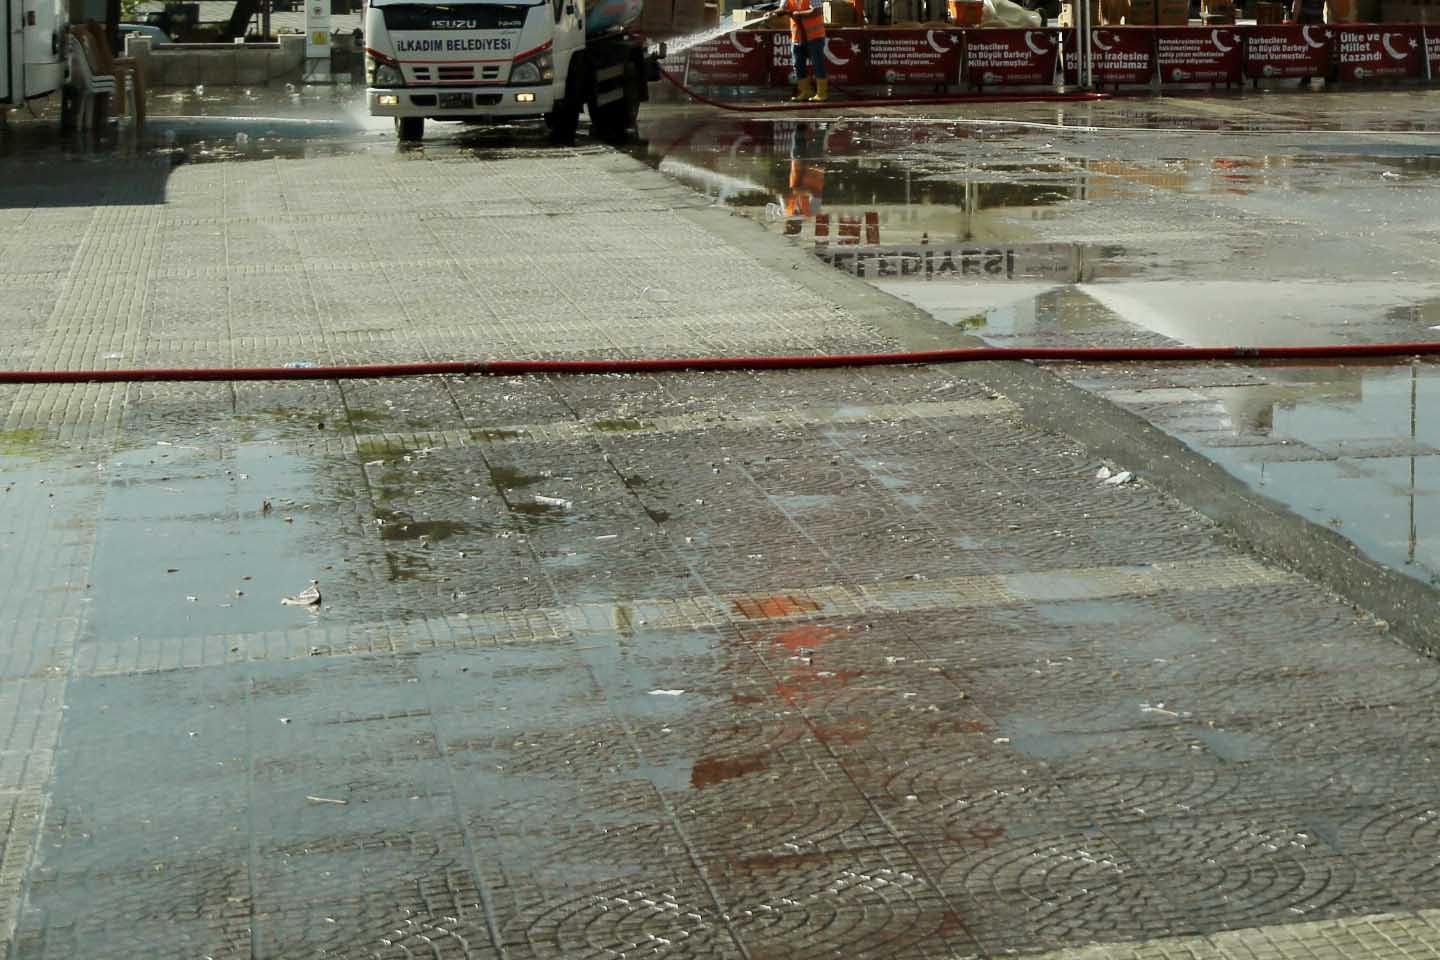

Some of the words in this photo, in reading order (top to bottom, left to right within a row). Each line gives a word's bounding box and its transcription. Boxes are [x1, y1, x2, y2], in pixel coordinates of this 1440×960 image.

[432, 19, 477, 29] ISUZU
[1341, 31, 1365, 42] Ülke
[1367, 33, 1380, 41] ve
[397, 40, 443, 52] İLKADIM
[446, 39, 511, 52] BELEDİYESİ
[1341, 43, 1371, 52] Millet
[1341, 51, 1382, 62] Kazandı
